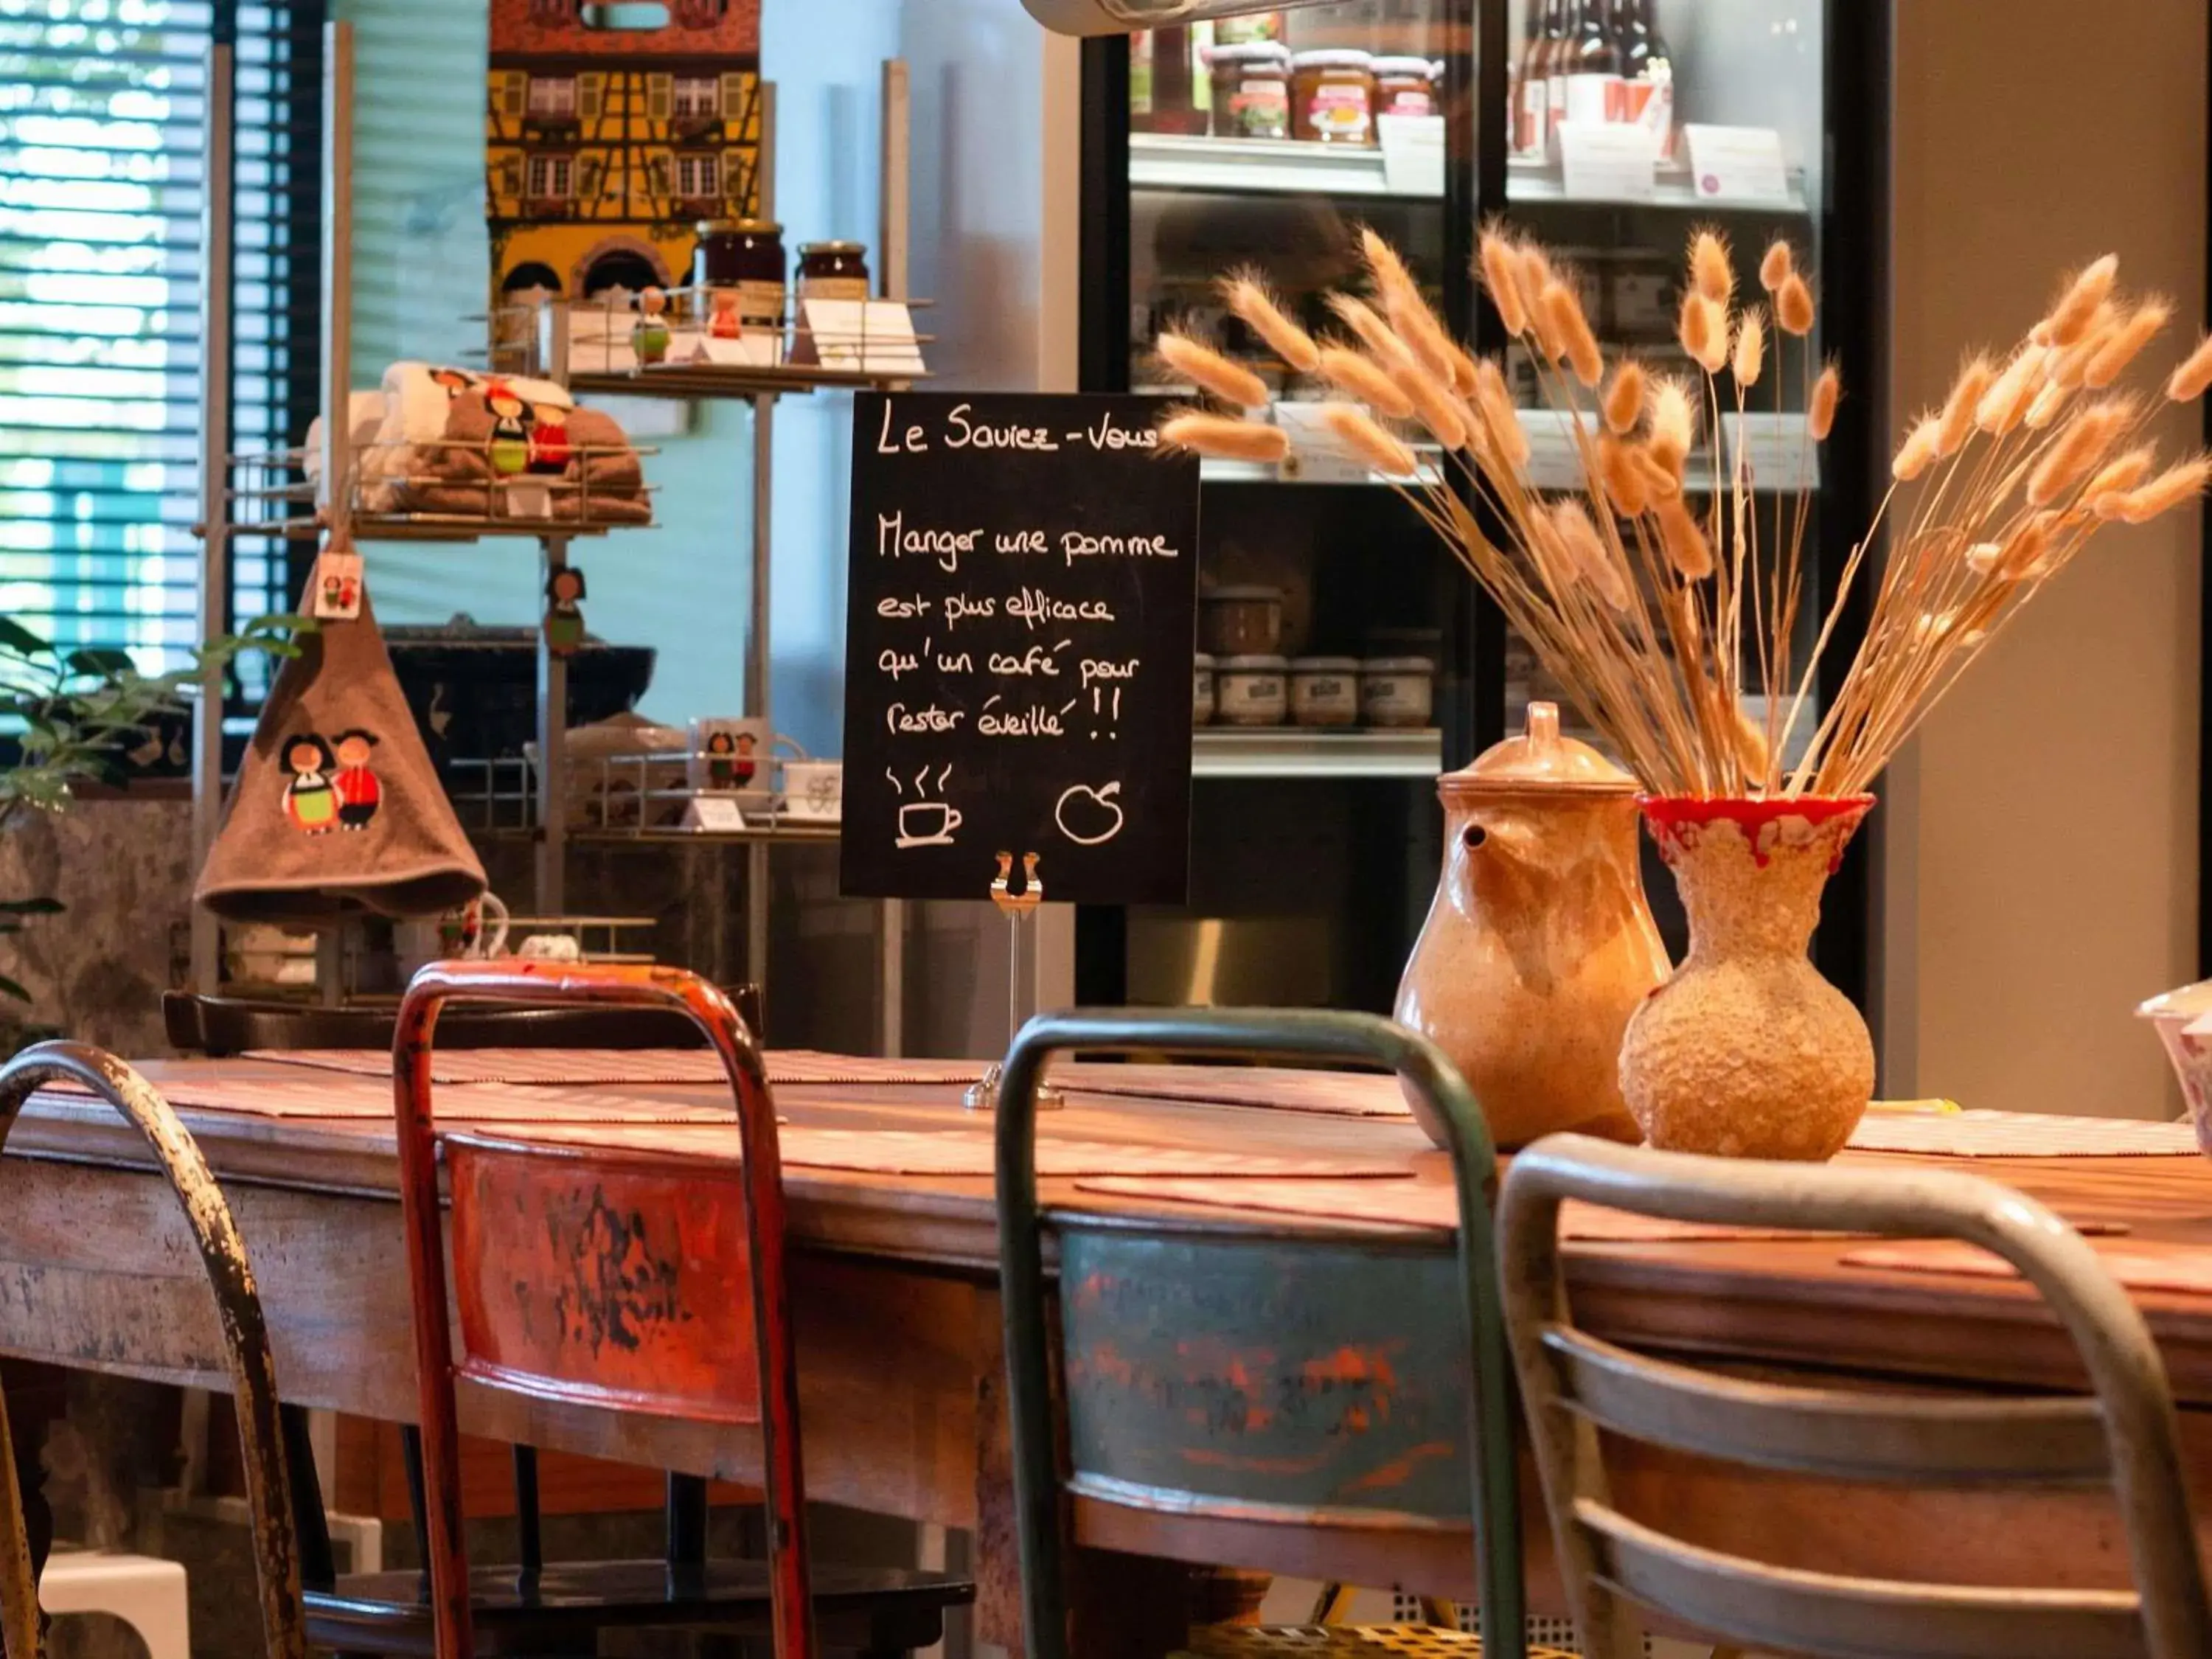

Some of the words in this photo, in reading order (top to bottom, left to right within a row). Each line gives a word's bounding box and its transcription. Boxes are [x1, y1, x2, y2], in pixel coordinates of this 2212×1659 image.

[877, 398, 928, 453] Le
[878, 510, 984, 572] Manger
[995, 530, 1048, 554] une
[1060, 531, 1178, 567] pomme
[877, 593, 931, 618] est
[945, 593, 996, 630] plus
[1005, 586, 1115, 630] efficace
[878, 636, 973, 681] qu'un
[988, 639, 1071, 676] café
[1079, 658, 1140, 689] pour
[887, 703, 965, 734] rester
[978, 695, 1077, 737] éveillé
